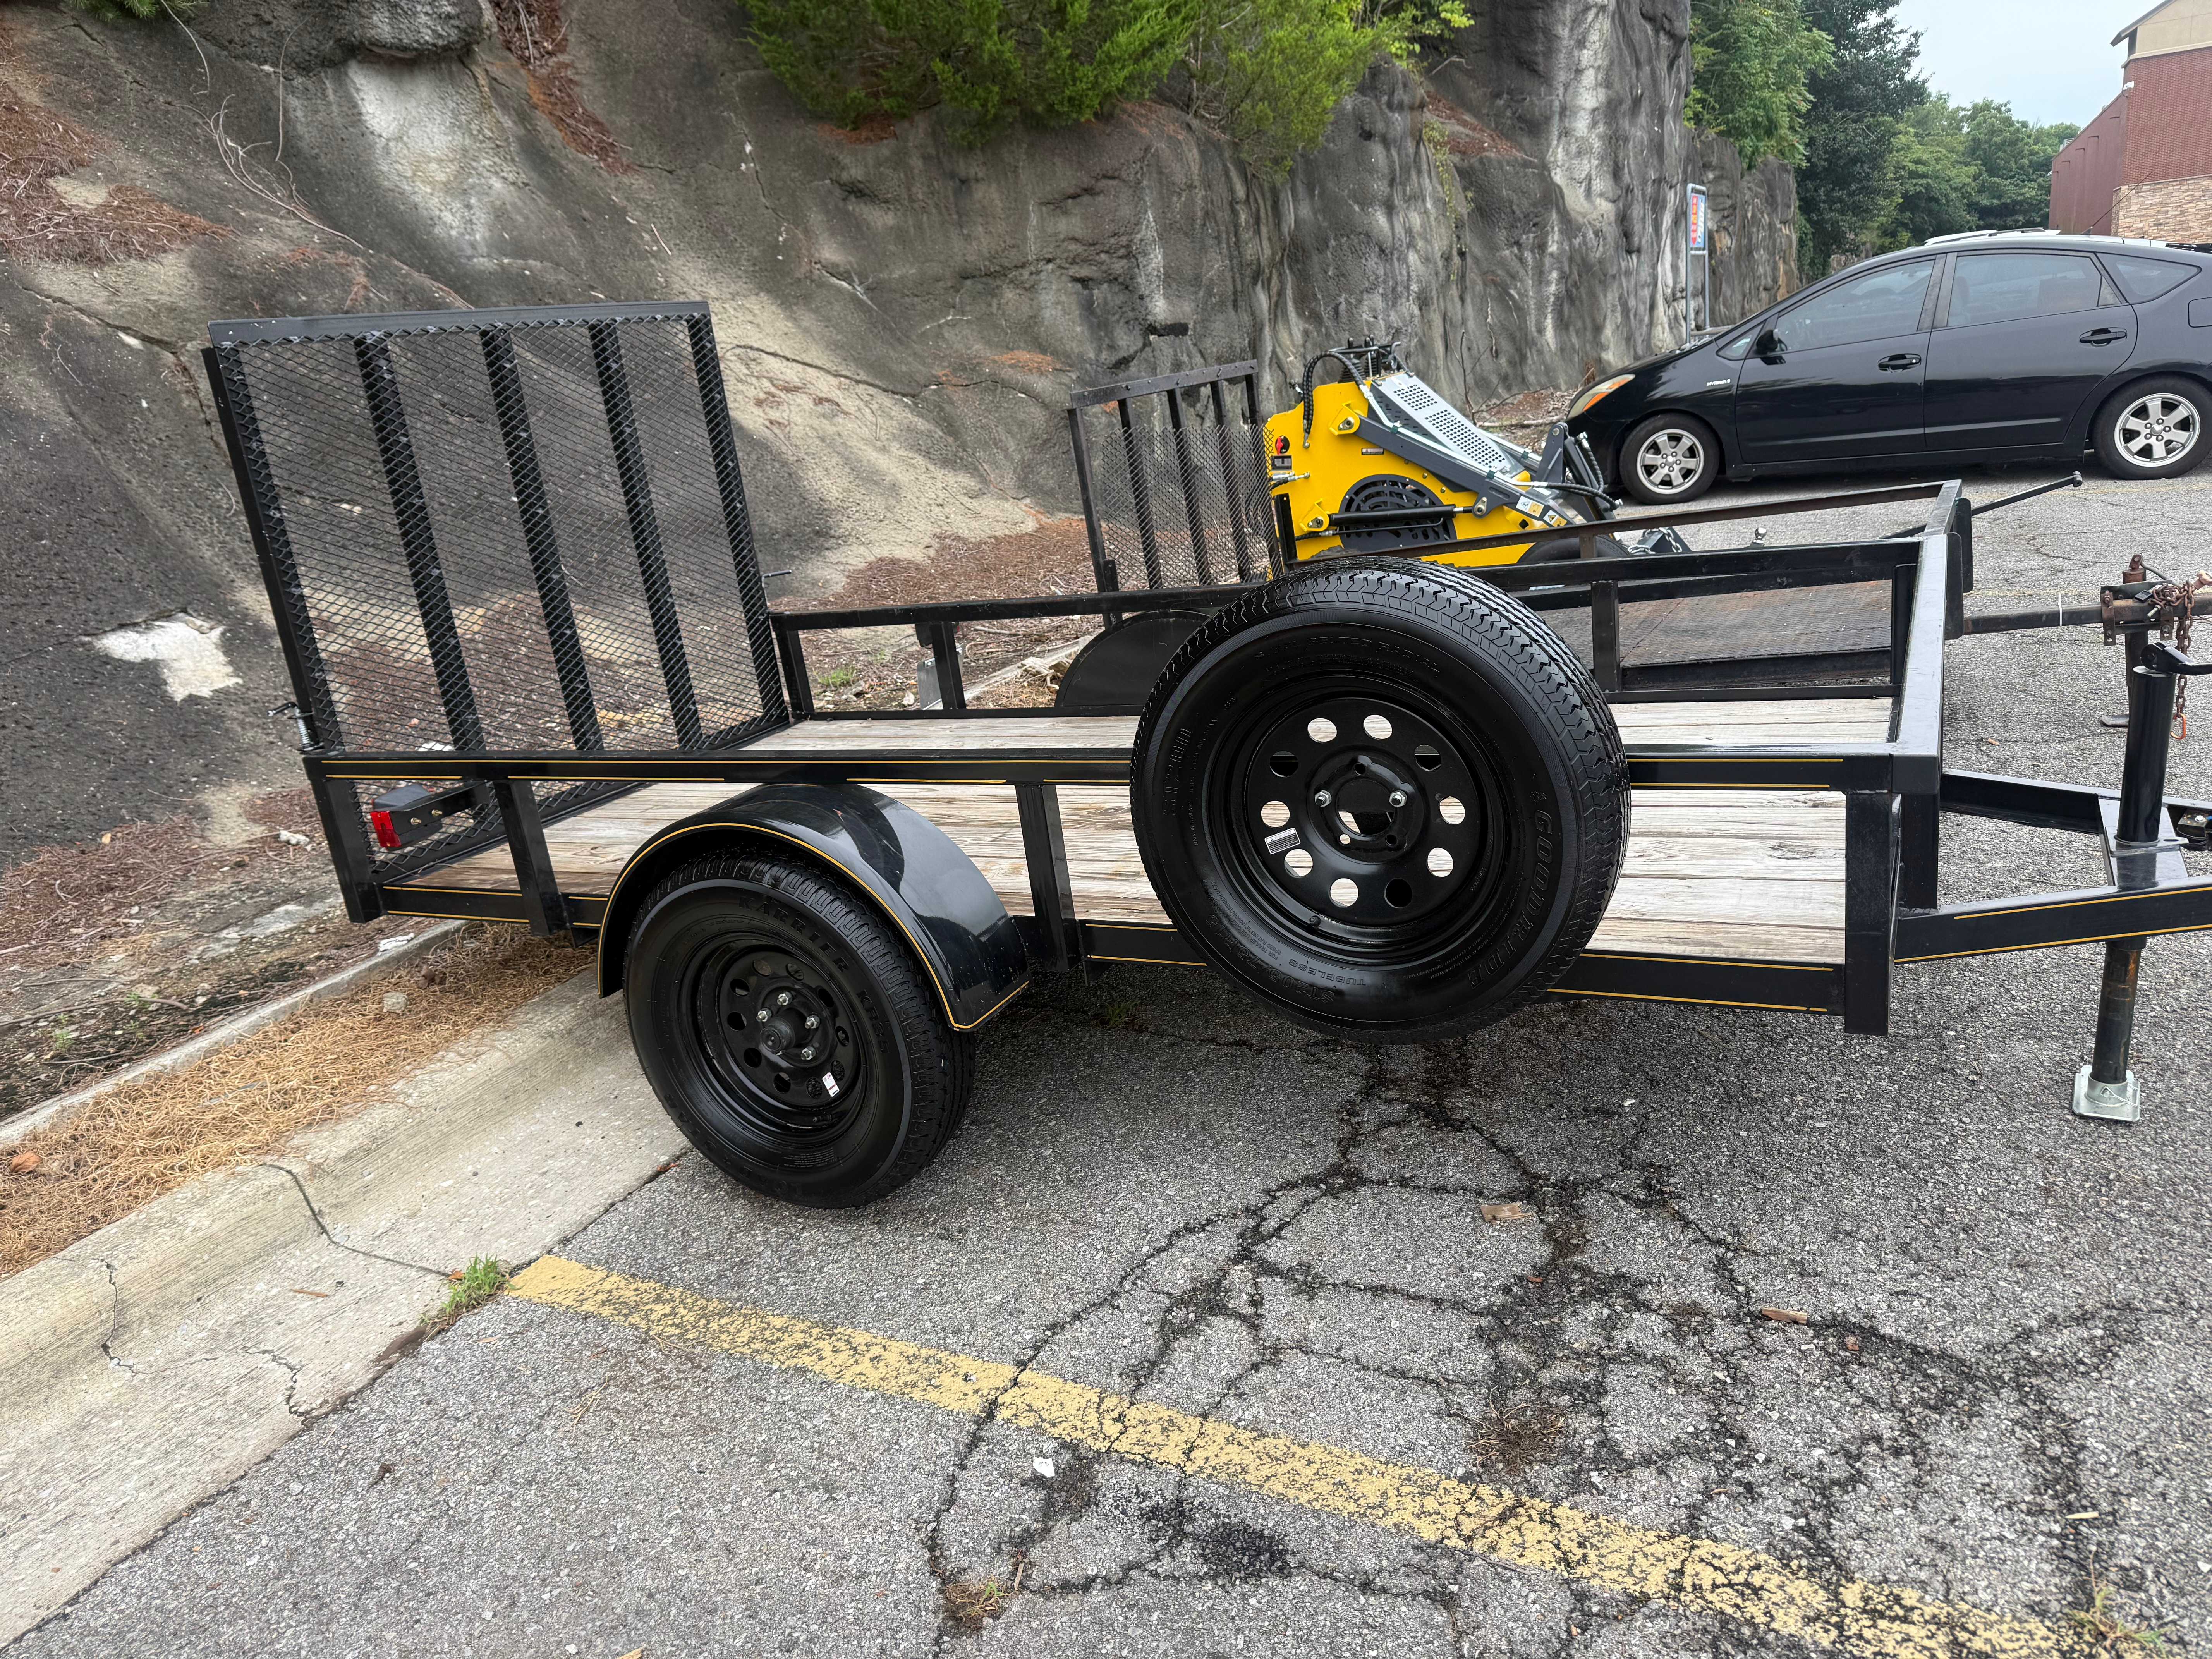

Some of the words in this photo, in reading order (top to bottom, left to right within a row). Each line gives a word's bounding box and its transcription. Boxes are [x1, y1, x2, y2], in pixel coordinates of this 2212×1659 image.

[1468, 809, 1554, 989] GOODRIDE
[738, 895, 849, 973] KARRIER
[1248, 936, 1269, 953] TRAILER
[1267, 951, 1279, 961] FOR
[1288, 959, 1366, 986] TUBELESS
